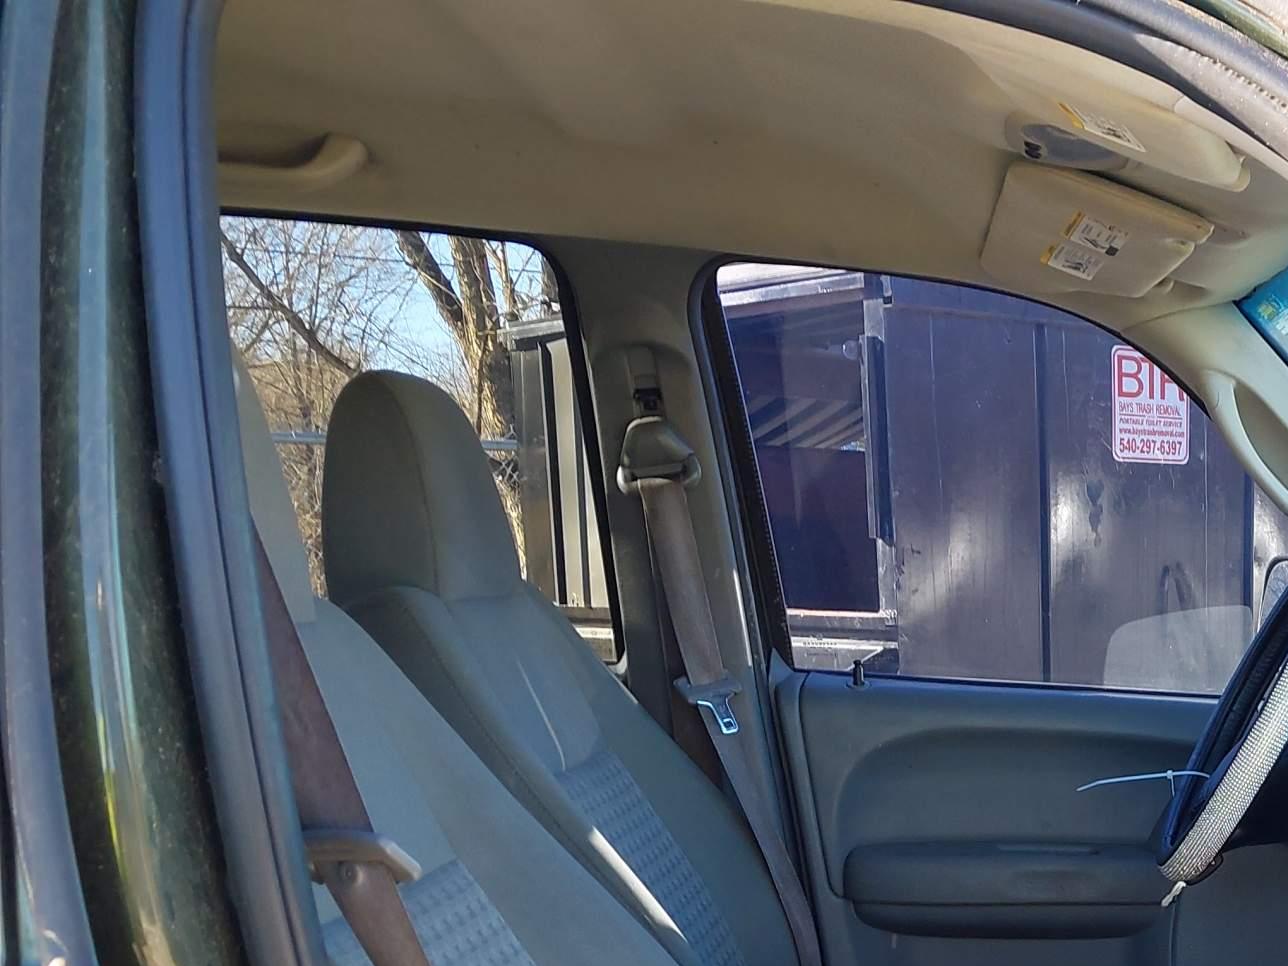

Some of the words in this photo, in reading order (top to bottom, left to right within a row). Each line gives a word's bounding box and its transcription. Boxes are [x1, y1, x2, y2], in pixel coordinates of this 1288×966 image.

[1119, 402, 1134, 413] BAYS
[1135, 403, 1155, 414] TRASH
[1156, 405, 1181, 417] REMOVAL
[1119, 438, 1183, 456] 540-297-6397
